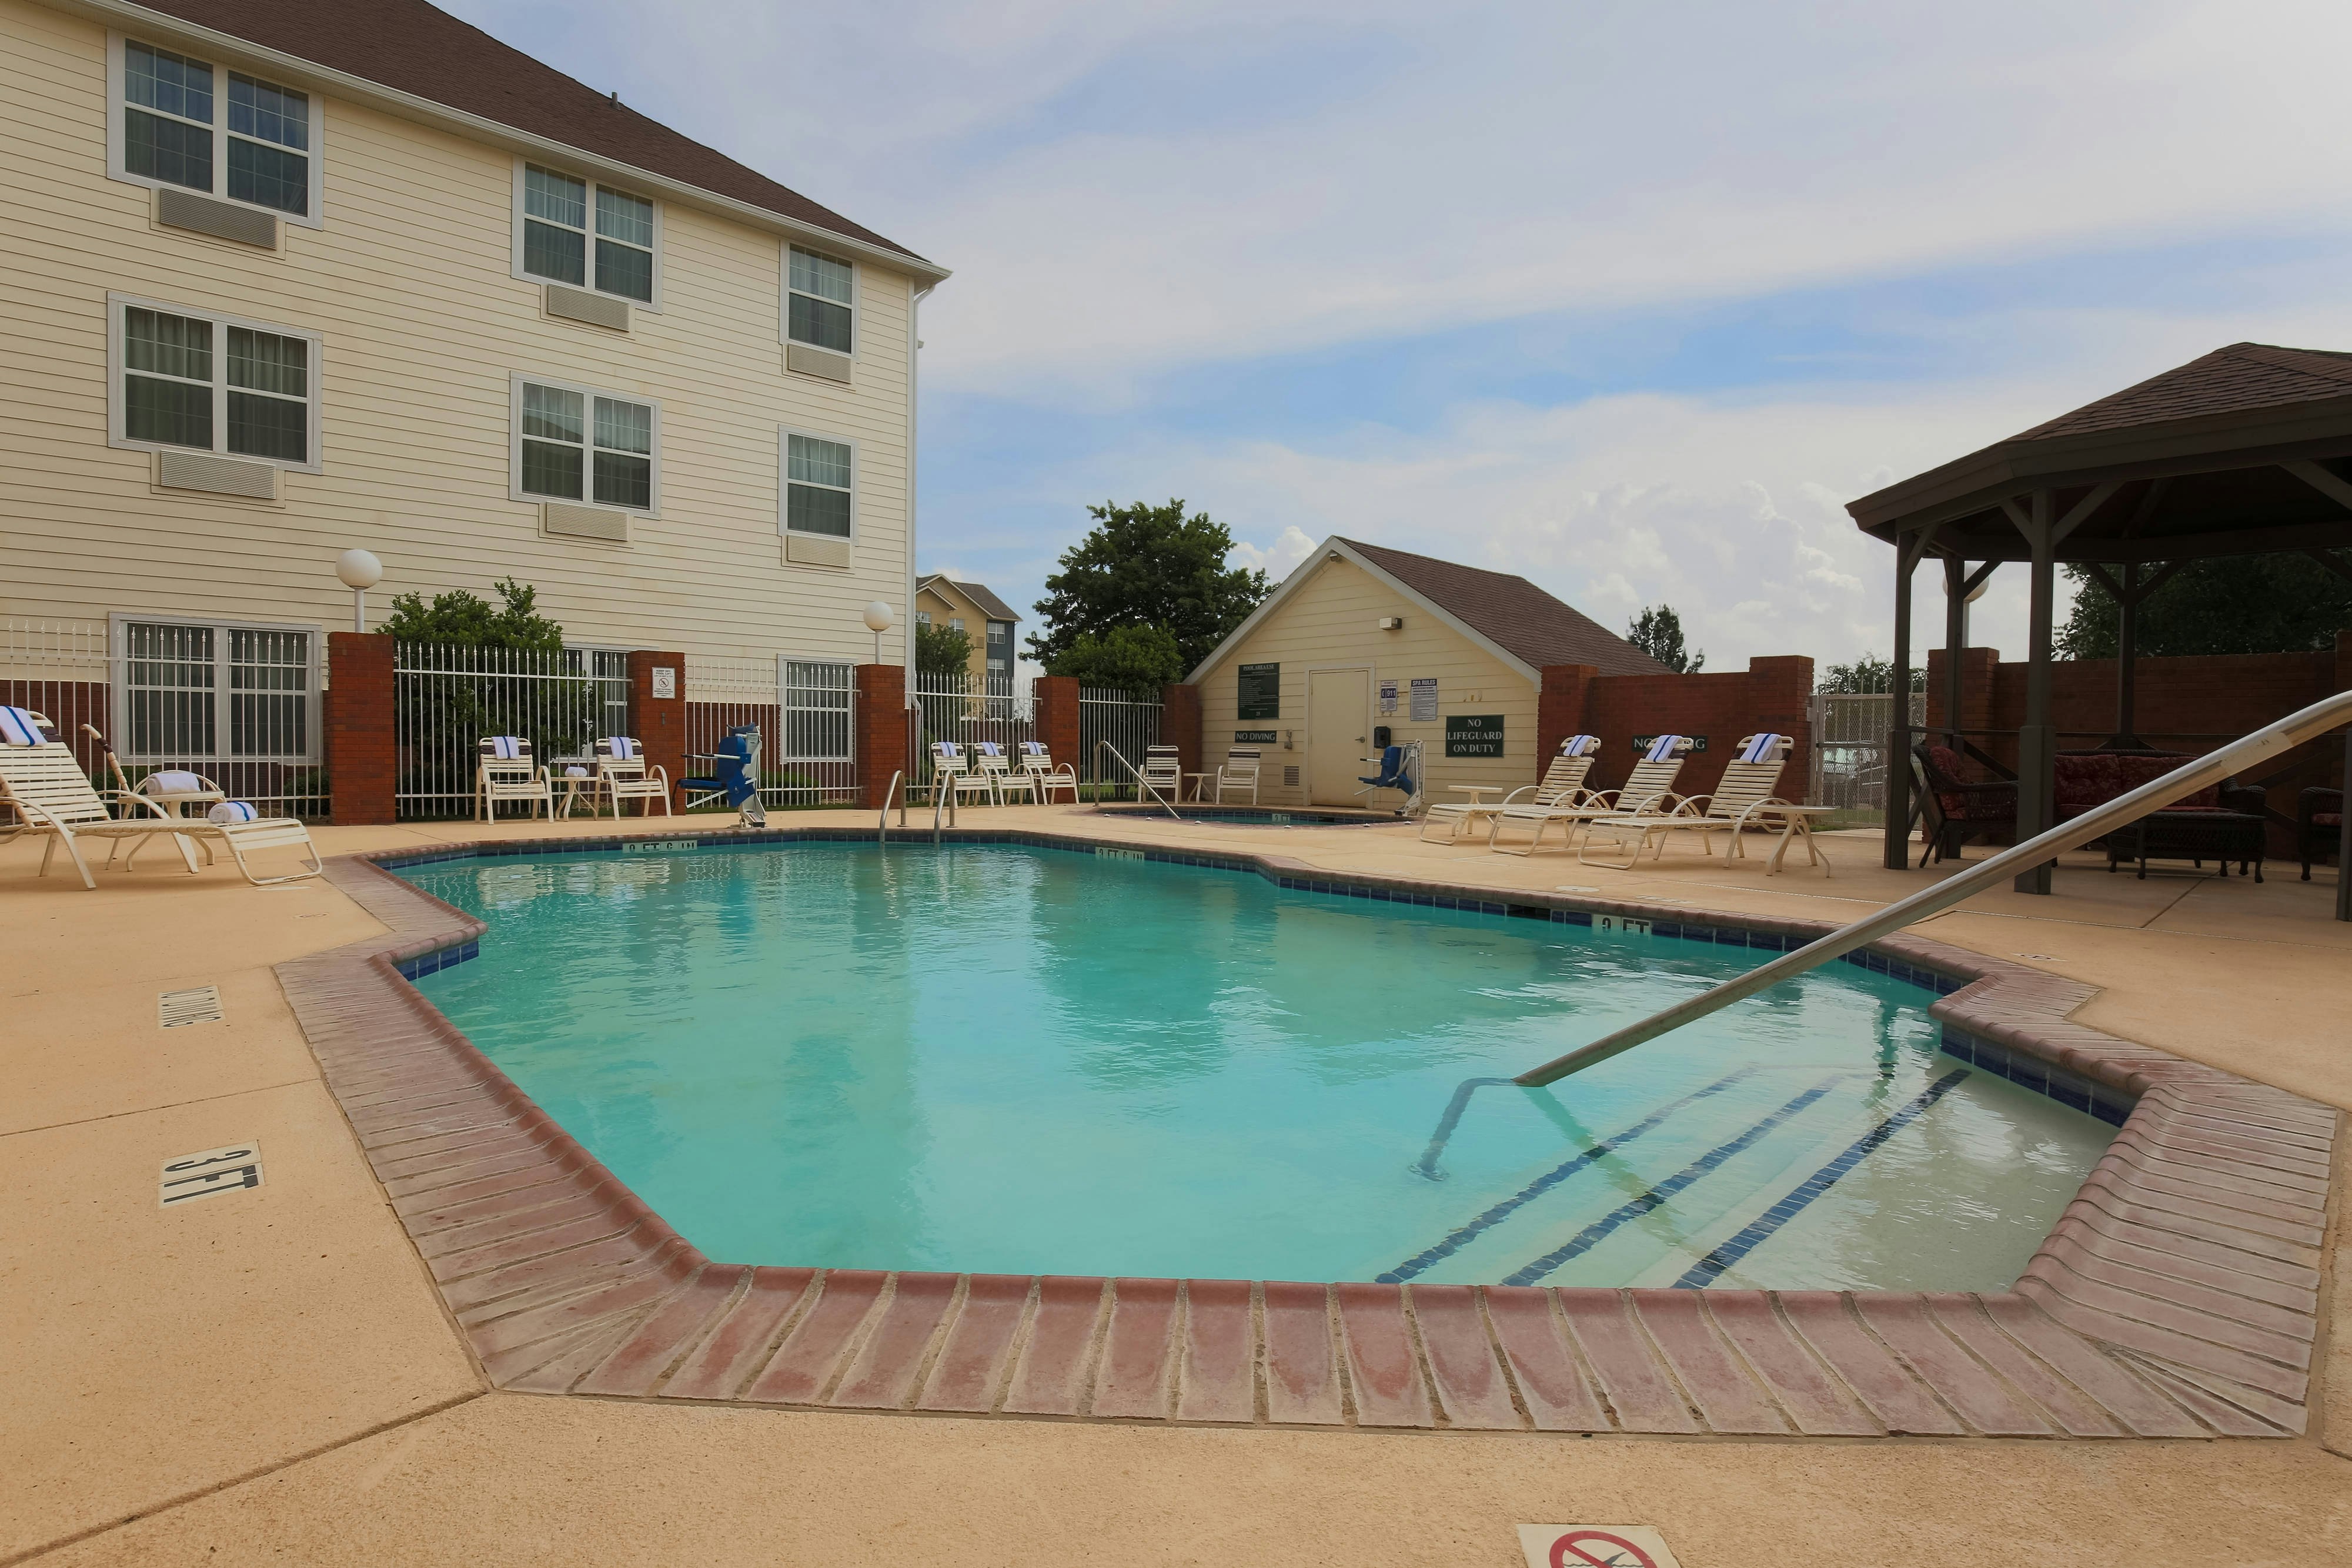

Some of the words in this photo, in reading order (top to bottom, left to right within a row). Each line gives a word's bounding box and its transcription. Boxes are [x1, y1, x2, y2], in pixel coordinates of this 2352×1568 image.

[1468, 718, 1482, 727] NO
[1250, 733, 1275, 741] DIVING
[1447, 731, 1502, 740] LIFEGUARD
[1454, 744, 1467, 753] ON
[1469, 744, 1496, 753] DUTY
[165, 1150, 252, 1172] 3
[163, 1165, 259, 1203] FT
